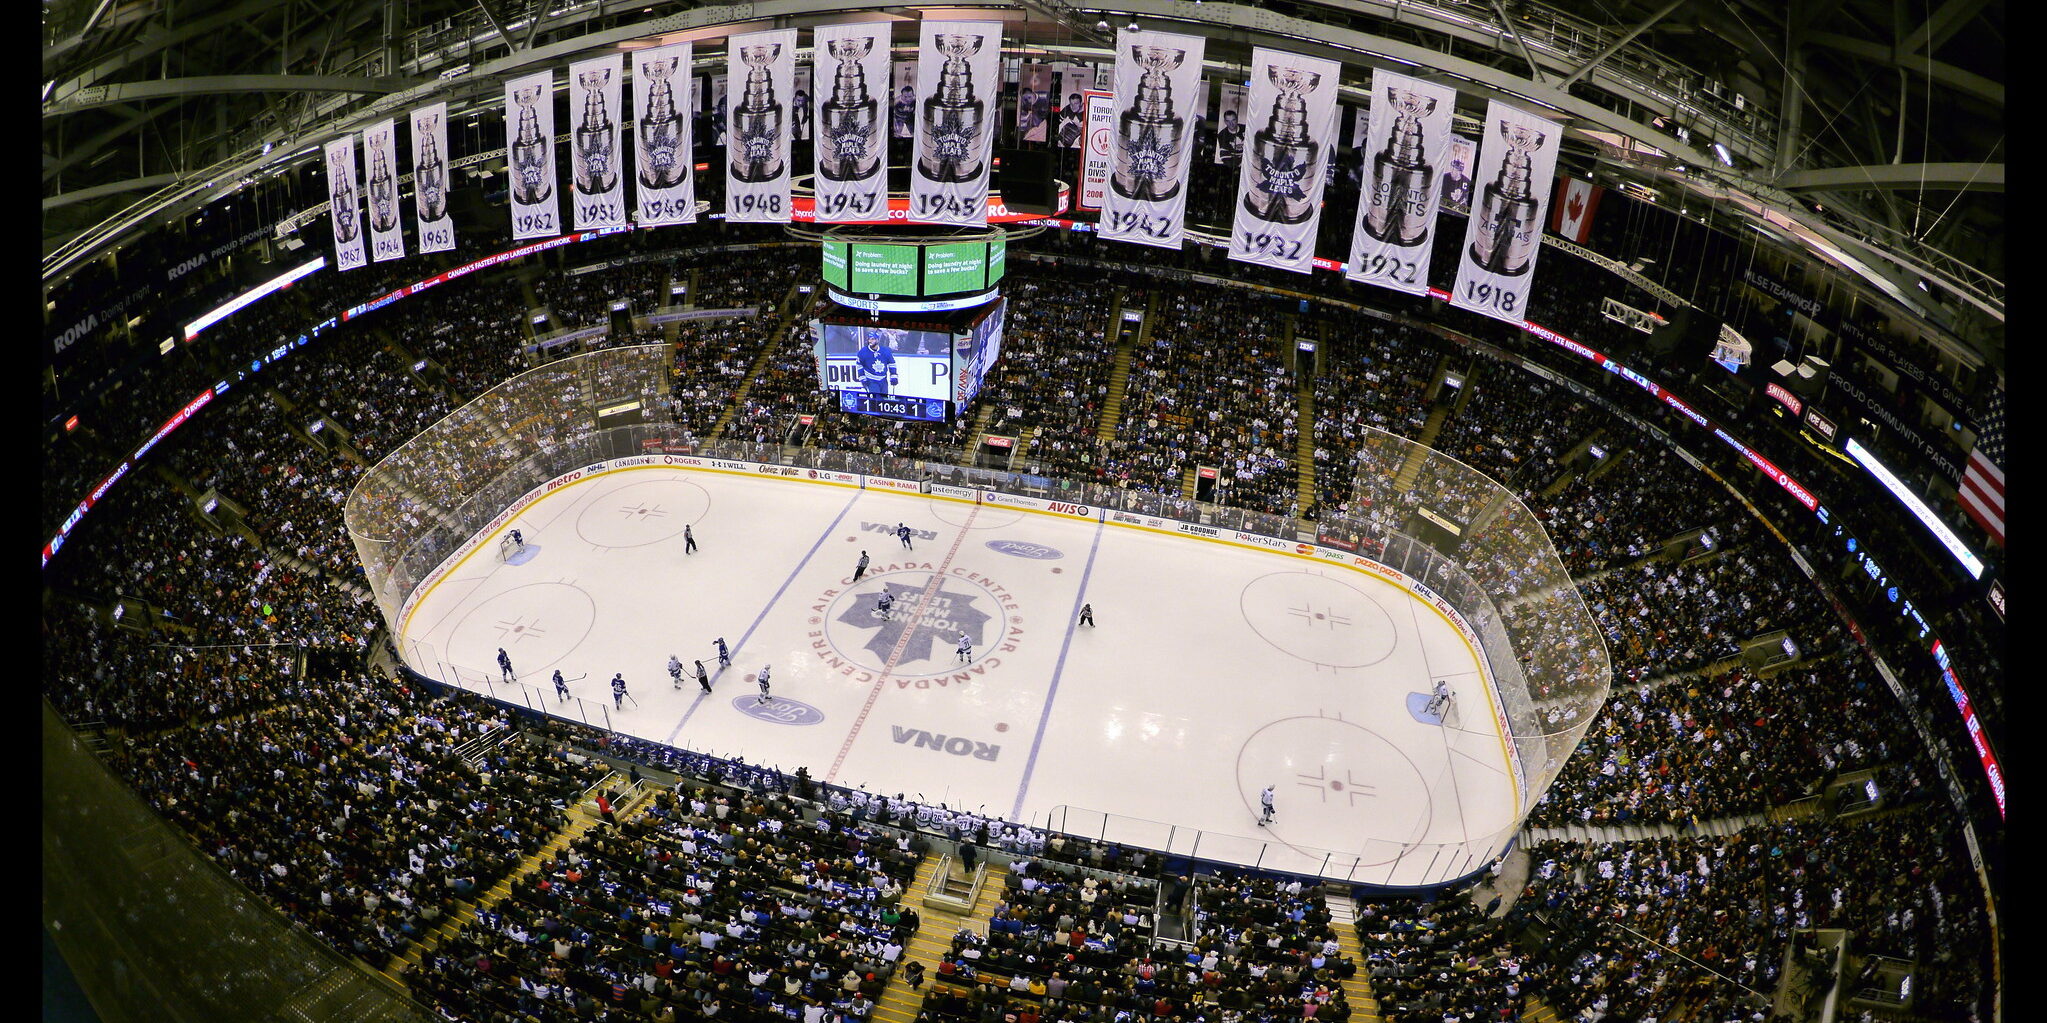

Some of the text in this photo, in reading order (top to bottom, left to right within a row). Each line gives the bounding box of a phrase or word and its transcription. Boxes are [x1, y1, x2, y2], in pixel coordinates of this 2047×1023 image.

[837, 134, 864, 144] TORONTO
[938, 134, 966, 144] TORONTO
[1266, 165, 1300, 178] TORONTO
[1269, 176, 1294, 186] MAPLE
[1269, 184, 1293, 194] LEAFS
[582, 204, 616, 222] 1951
[644, 198, 686, 219] 1949
[733, 194, 782, 214] 1948
[824, 193, 877, 214] 1947
[919, 194, 976, 216] 1945
[517, 213, 554, 232] 1962
[1112, 211, 1172, 238] 1942
[376, 240, 399, 258] 1964
[422, 230, 449, 248] 1963
[1244, 232, 1303, 260] 1932
[168, 226, 274, 282] RONA PROUD SPONSOR
[340, 248, 360, 266] 1967
[448, 263, 476, 279] CANADA'S
[474, 254, 496, 272] FASTEST
[509, 246, 533, 260] LARGEST
[543, 236, 571, 250] NETWORK
[1360, 253, 1418, 284] 1922
[1744, 268, 1769, 288] MLSE
[848, 298, 878, 310] SPORTS
[1467, 281, 1517, 312] 1918
[1125, 312, 1139, 322] IBM
[53, 313, 99, 354] RONA
[1529, 324, 1596, 360] LARGEST LTE NETWORK
[1299, 342, 1314, 352] IBM
[1841, 322, 1864, 340] WITH
[1867, 336, 1887, 354] OUR
[1887, 346, 1926, 380] PLAYERS
[1926, 376, 1942, 392] TO
[957, 368, 968, 401] RE/MAX
[1446, 378, 1461, 388] IBM
[190, 392, 211, 413] ROGERS
[864, 400, 918, 416] 1 10:43 1
[1766, 384, 1800, 413] SMIRNOFF
[1829, 370, 1866, 402] PROUD
[1867, 398, 1926, 448] COMMUNITY
[1666, 395, 1708, 426] rogers.com/LTE
[1808, 412, 1834, 437] ICE BOX
[588, 464, 605, 472] NHL
[614, 458, 644, 468] CANADIAN
[674, 458, 702, 466] ROGERS
[758, 464, 778, 475] Cheez
[546, 471, 582, 492] metro
[819, 472, 830, 480] LG
[870, 478, 918, 490] CASINO RAMA
[1748, 452, 1766, 468] CANADA
[1786, 482, 1814, 508] ROGERS
[1048, 502, 1076, 514] AVIS
[1004, 540, 1050, 558] Ford
[1234, 532, 1287, 549] PokerStars
[420, 568, 445, 592] Scotiabank
[1354, 557, 1403, 582] pizza pizza
[952, 567, 1019, 610] CENTRE
[1414, 583, 1432, 600] NHL
[812, 588, 839, 613] AIR
[1435, 598, 1468, 636] Tim Hortons
[999, 626, 1024, 654] AIR
[808, 630, 872, 684] CENTRE
[896, 658, 1002, 690] CANADA
[750, 698, 808, 722] Ford
[1966, 714, 1981, 733] LTE
[892, 724, 1001, 762] RONA
